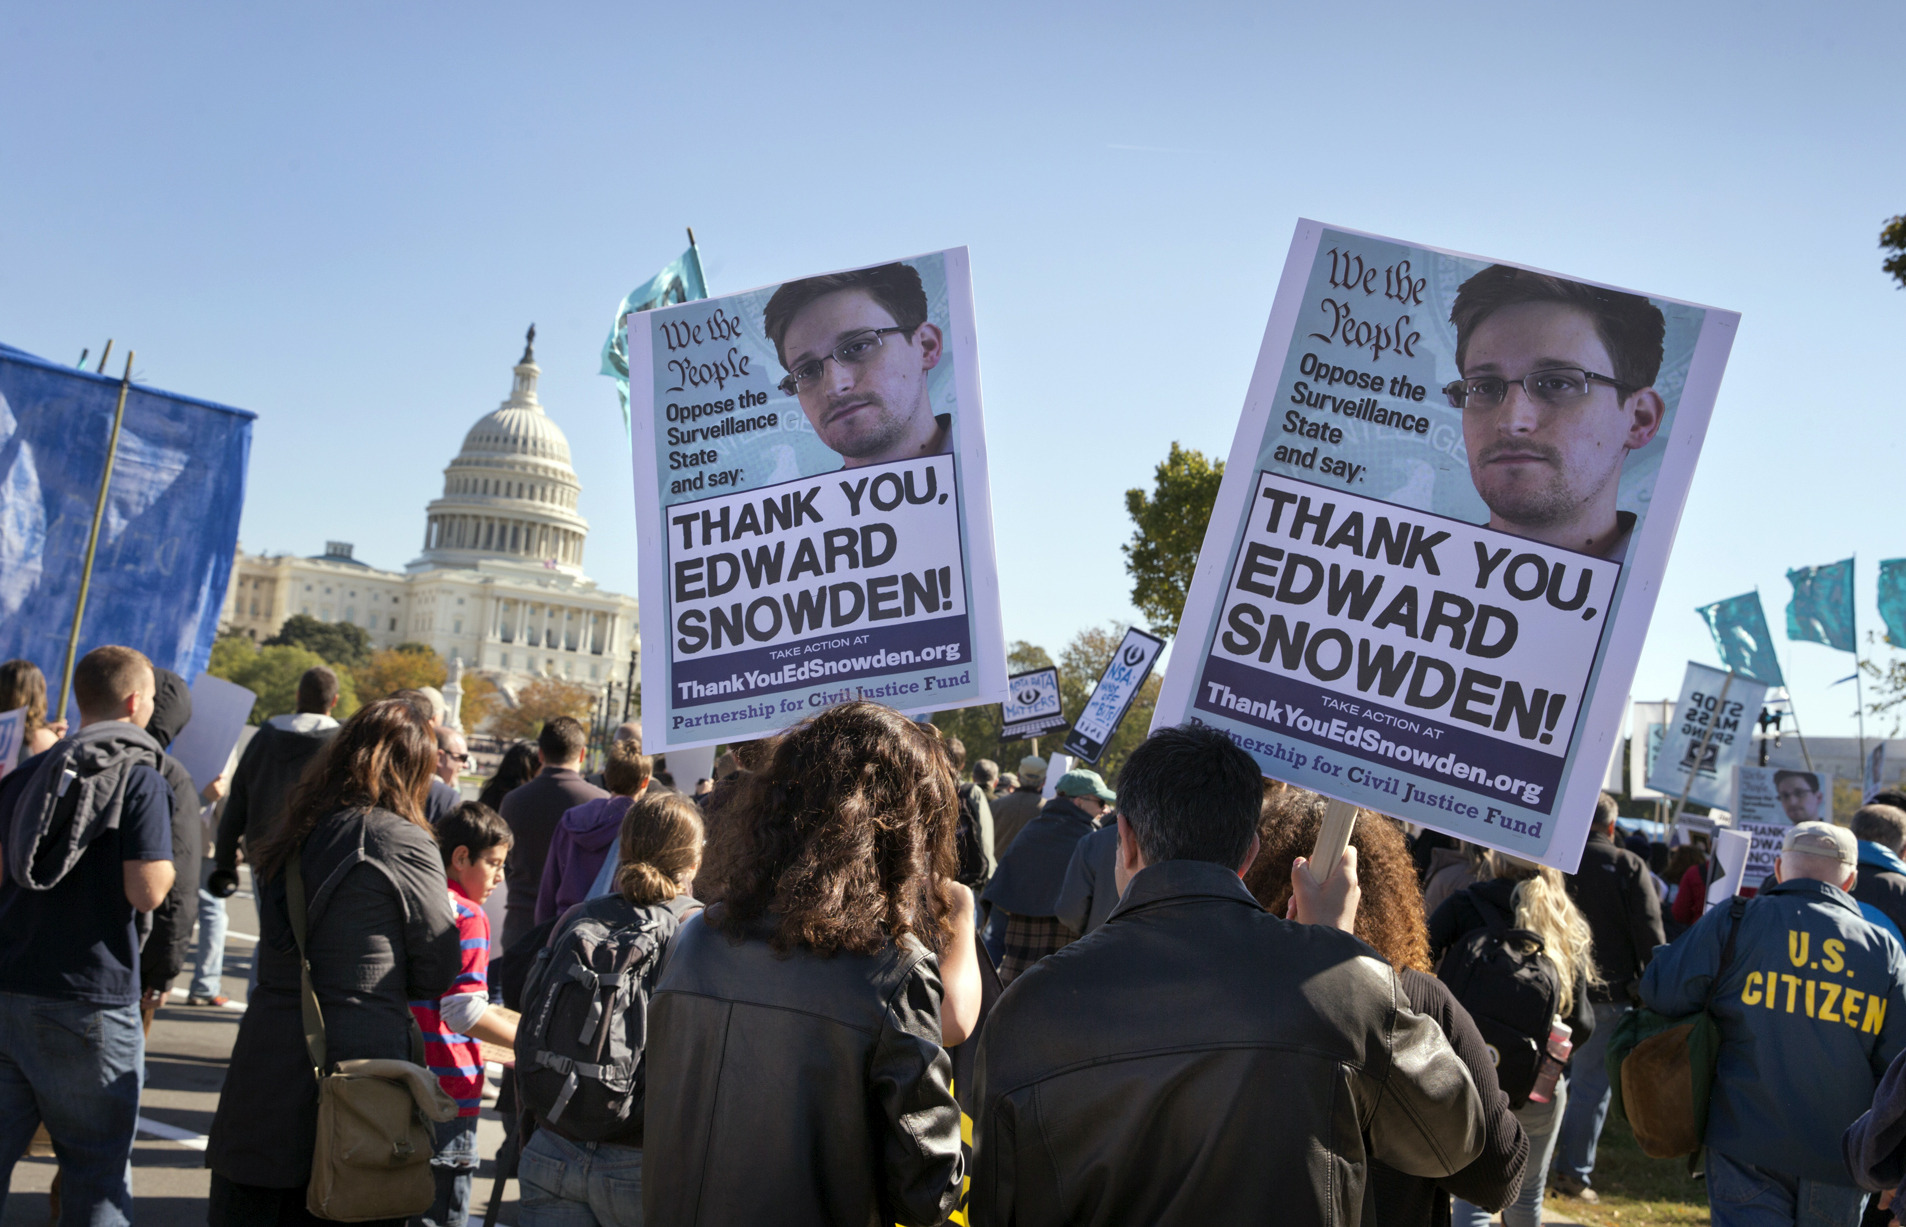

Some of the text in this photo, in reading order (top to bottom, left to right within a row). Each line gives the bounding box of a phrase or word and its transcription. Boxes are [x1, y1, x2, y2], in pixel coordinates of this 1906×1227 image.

[1325, 247, 1377, 296] We
[1385, 259, 1427, 307] the
[659, 308, 742, 352] We the
[1308, 298, 1421, 362] People
[666, 346, 751, 393] People
[1299, 352, 1427, 402] Oppose the
[666, 390, 768, 424] Oppose the
[667, 412, 778, 447] Surveillance
[1281, 410, 1343, 444] State
[1290, 381, 1430, 434] Surveillance
[669, 449, 718, 470] State
[671, 468, 745, 495] and say:
[1273, 444, 1366, 484] and say:
[672, 465, 950, 550] THANK YOU,
[674, 521, 898, 604] EDWARD
[1263, 487, 1598, 621] THANK YOU,
[676, 566, 952, 655] SNOWDEN!
[1236, 542, 1519, 660] EDWARD
[678, 642, 961, 701] ThankYouEdSnowden.org
[769, 634, 870, 661] TAKE ACTION AT
[1106, 662, 1136, 687] NSA:
[1221, 602, 1567, 746] SNOWDEN!
[672, 670, 971, 731] Partnership for Civil Justice Fund
[1005, 695, 1056, 719] MATTERS
[1322, 696, 1444, 740] TAKE ACTION AT
[1206, 682, 1544, 805] ThankYouEdSnowden.org
[1191, 716, 1542, 840] Pnership for Civil Justice Fund
[1741, 824, 1786, 838] THANK
[1788, 929, 1854, 978] U.S.
[1741, 970, 1887, 1036] CITIZEN
